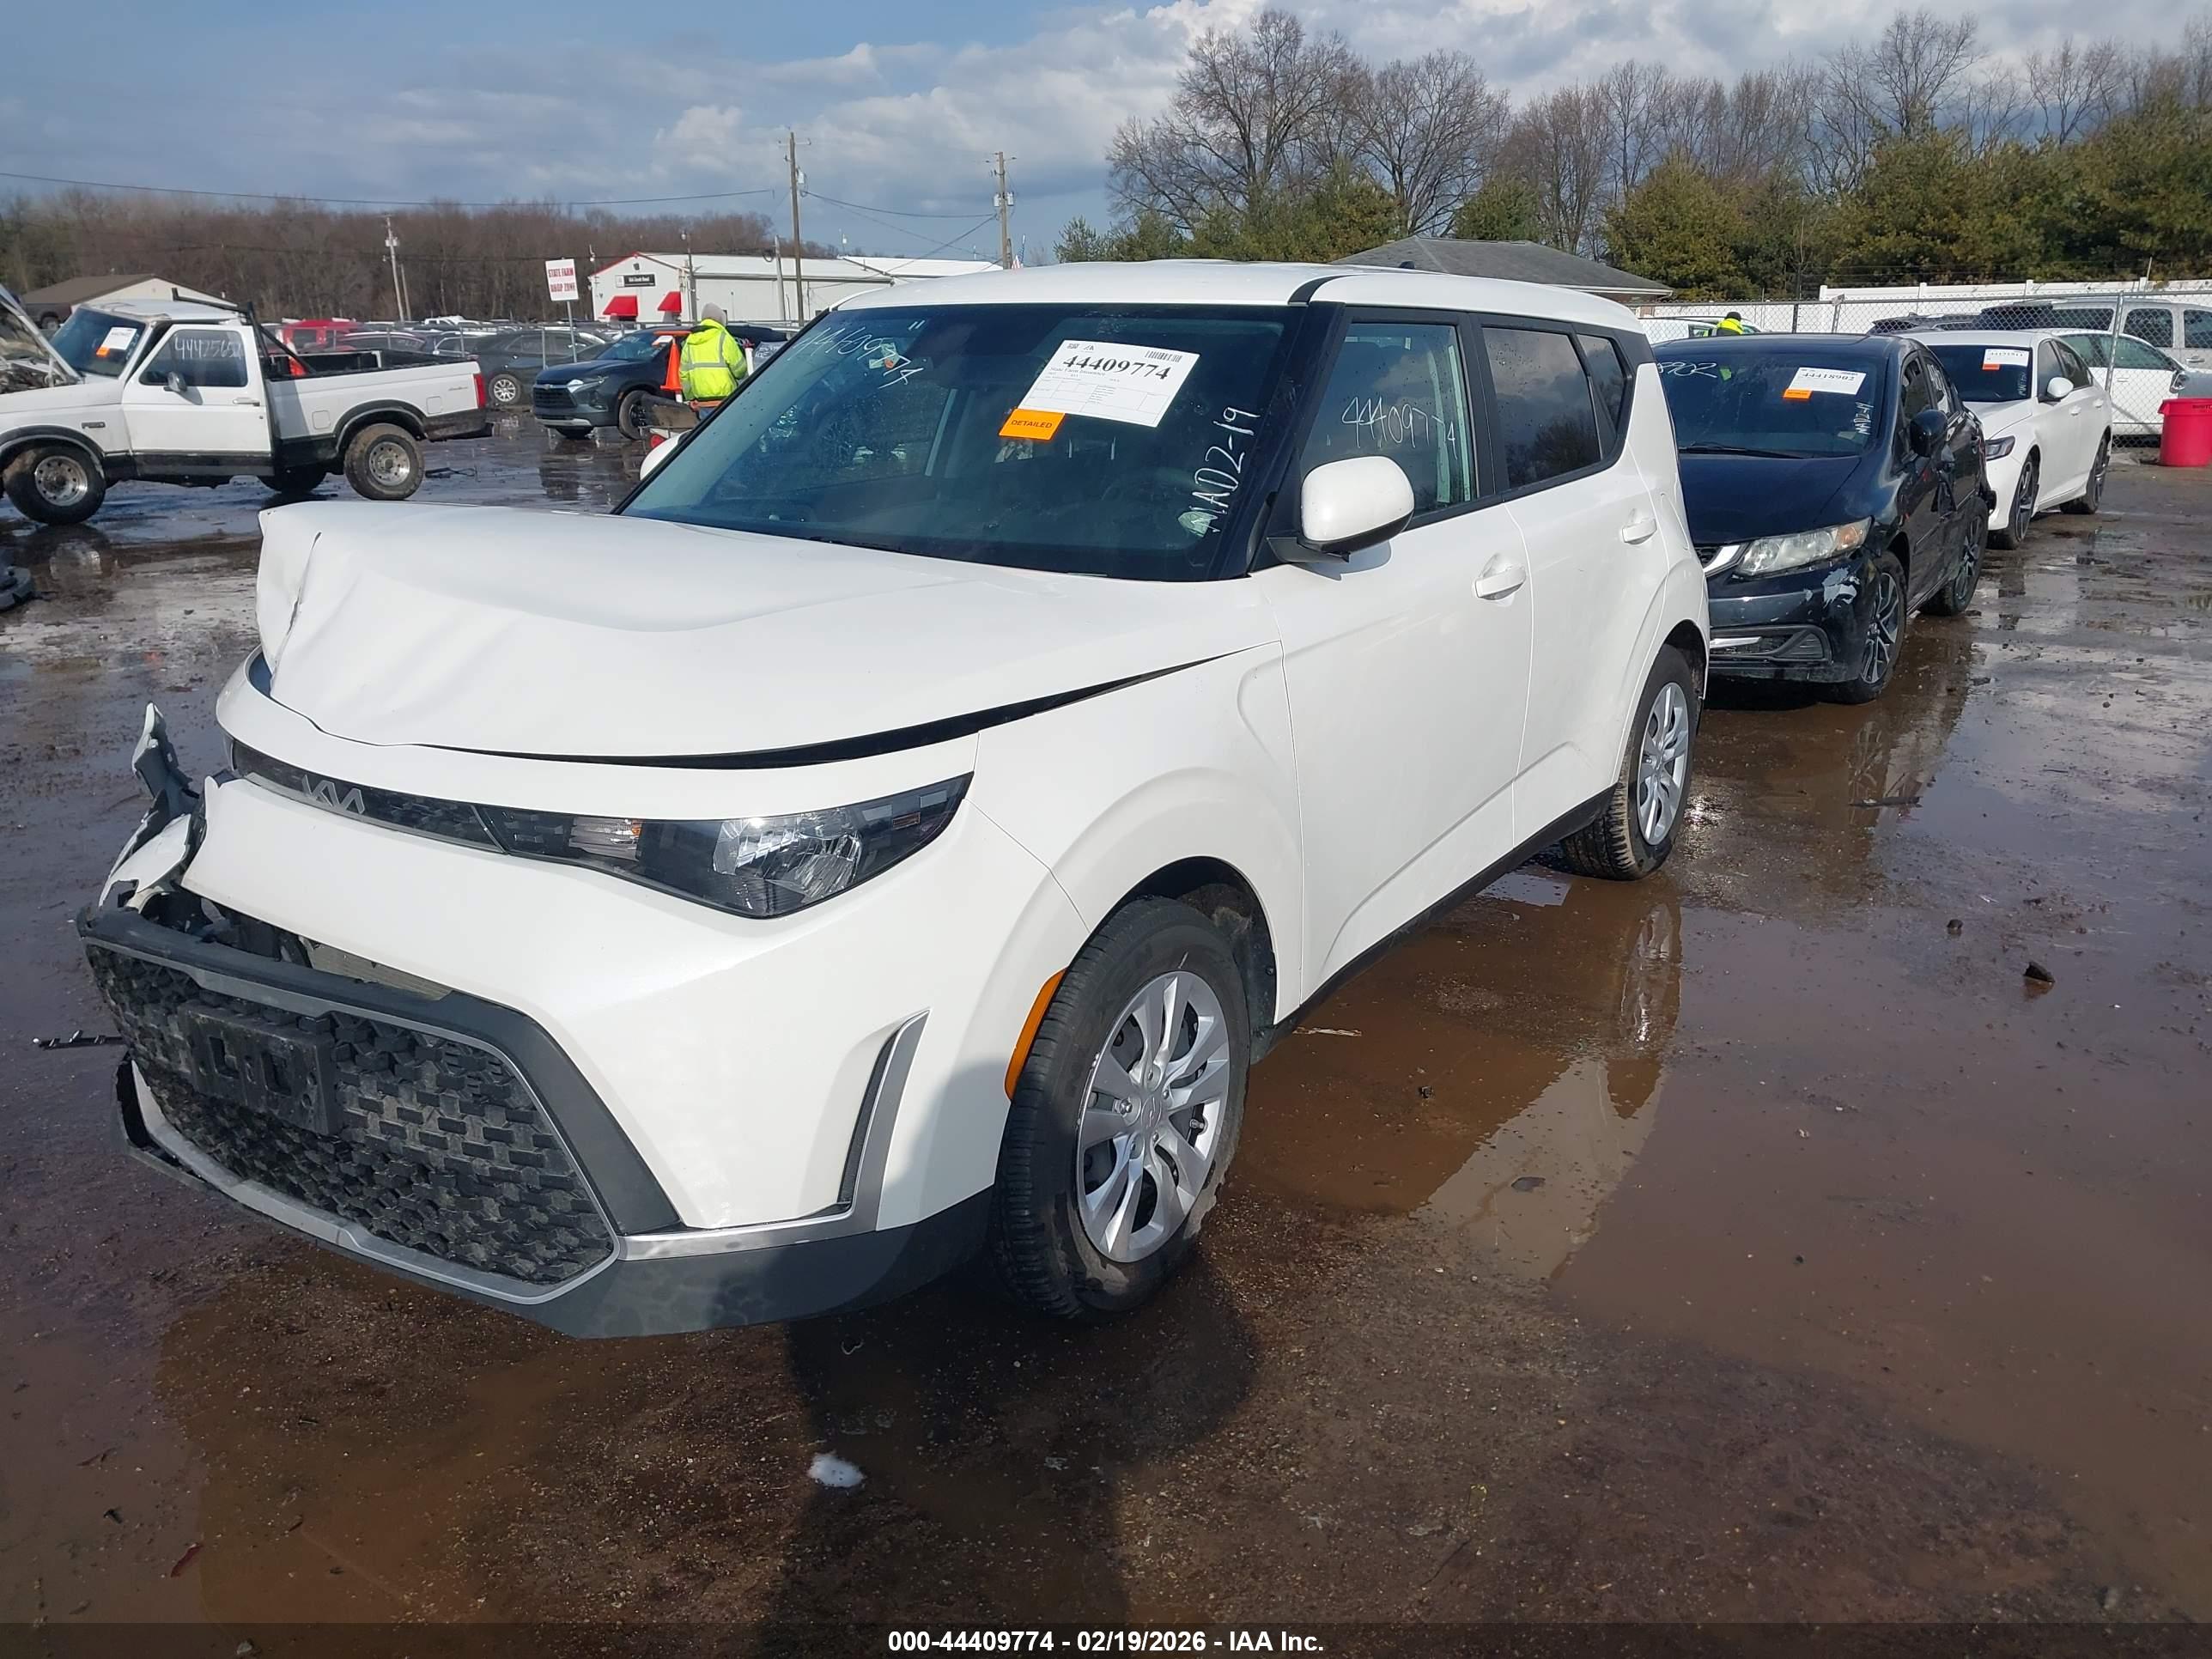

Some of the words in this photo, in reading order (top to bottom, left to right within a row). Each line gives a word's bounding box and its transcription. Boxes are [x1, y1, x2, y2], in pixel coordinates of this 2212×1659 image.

[1063, 355, 1171, 380] 44409774
[1011, 419, 1053, 428] DETAILED
[1341, 396, 1457, 459] 44409774
